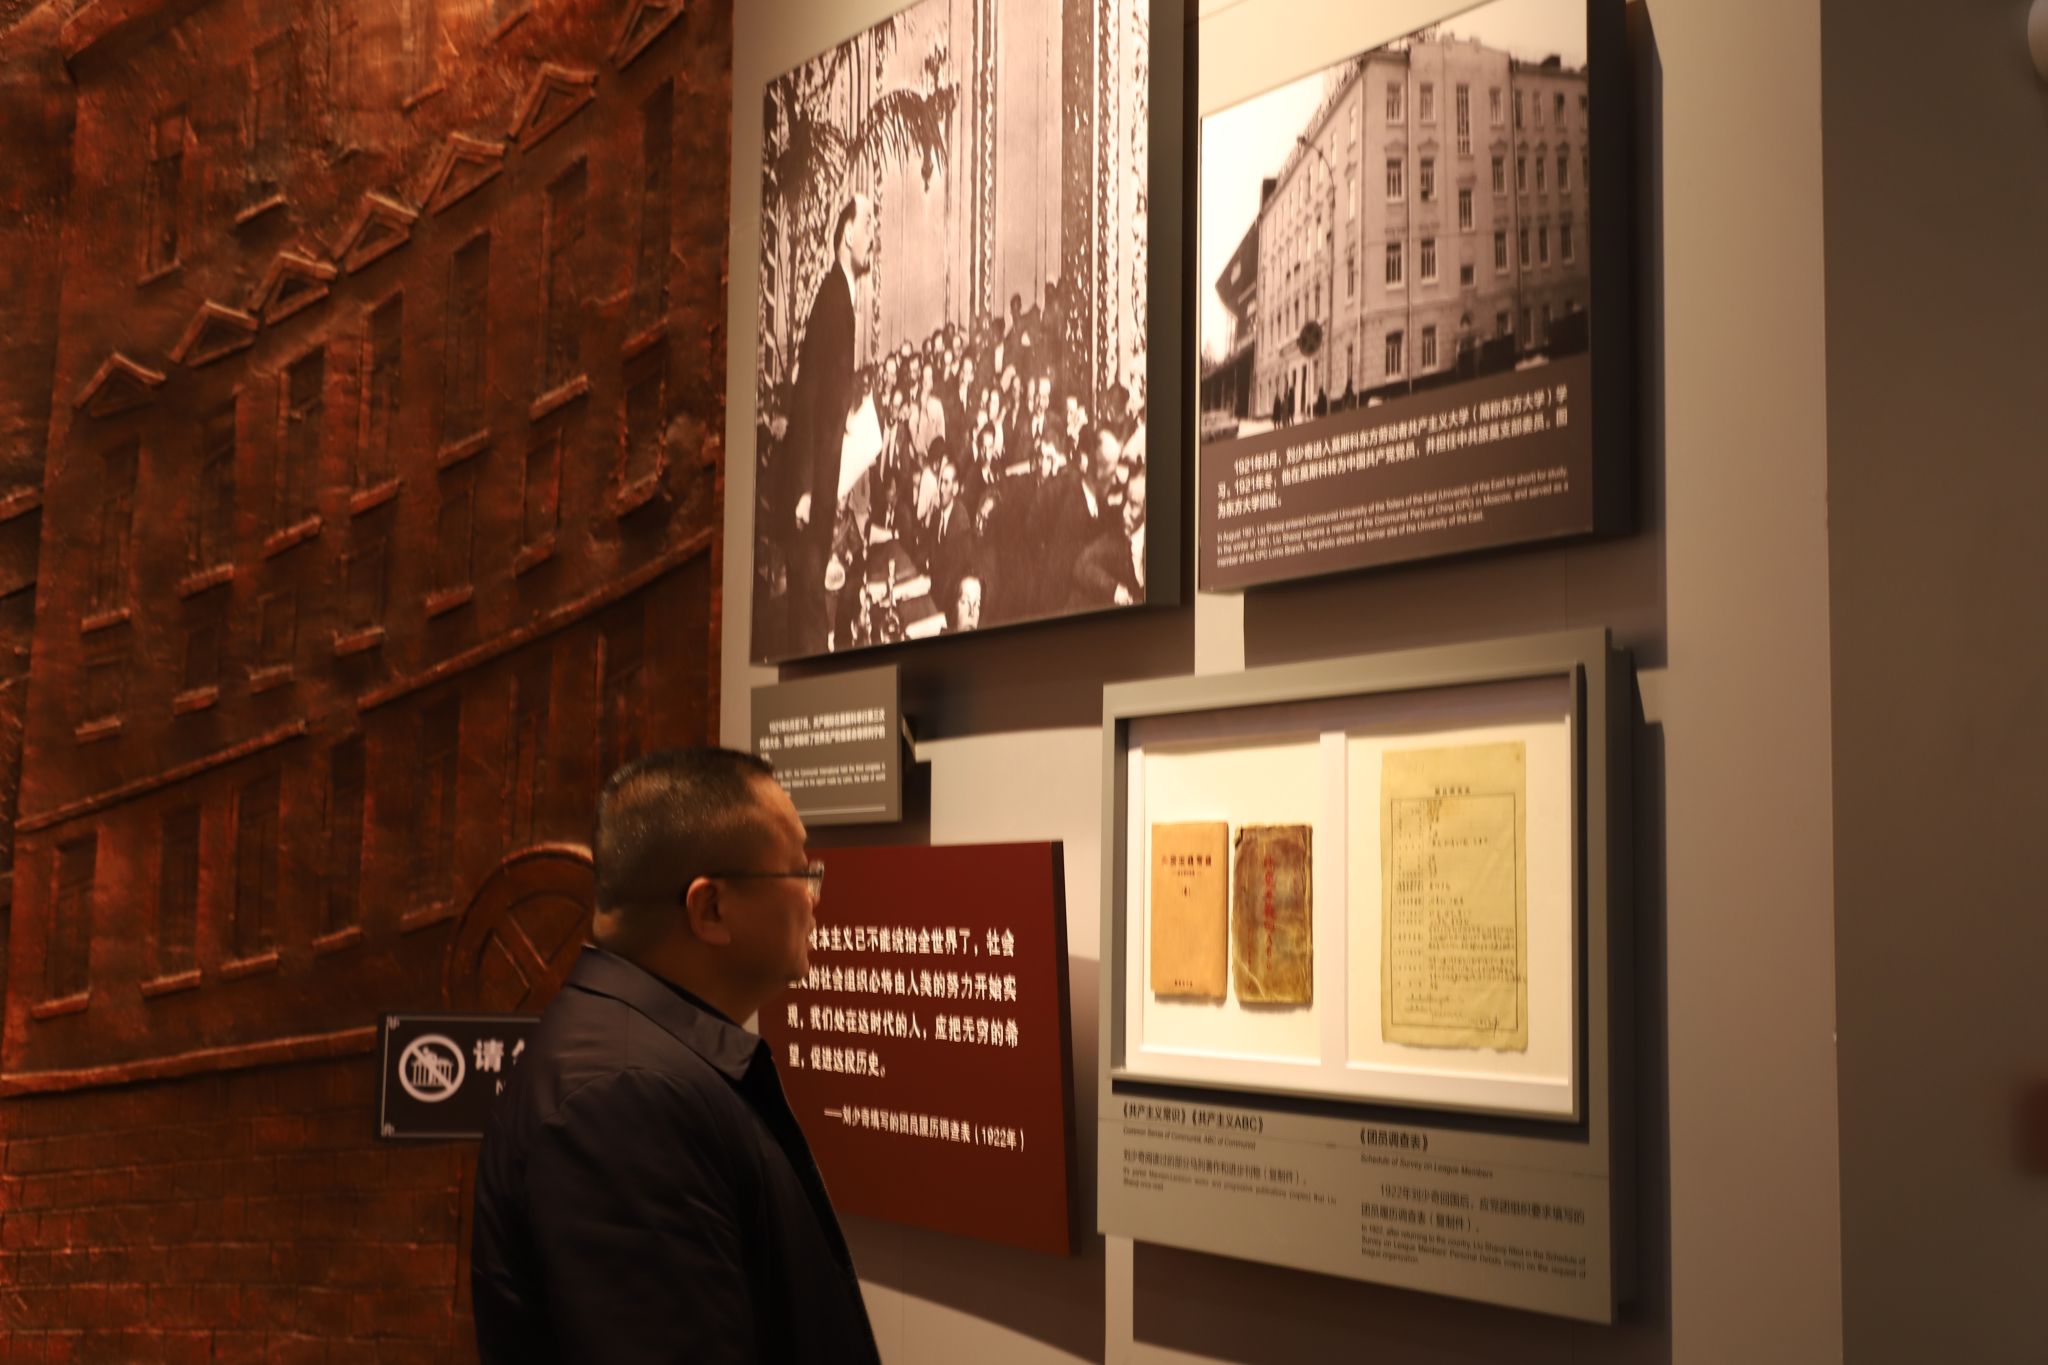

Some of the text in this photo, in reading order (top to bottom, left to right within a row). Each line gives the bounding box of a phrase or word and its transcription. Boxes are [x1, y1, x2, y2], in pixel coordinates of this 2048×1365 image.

[788, 966, 1017, 1002] 的社会组织必将由人类的努力开始实
[787, 1003, 1019, 1048] 现，我们处在这时代的人，应把无穷的希
[788, 1042, 887, 1078] 望，促进这段历史。
